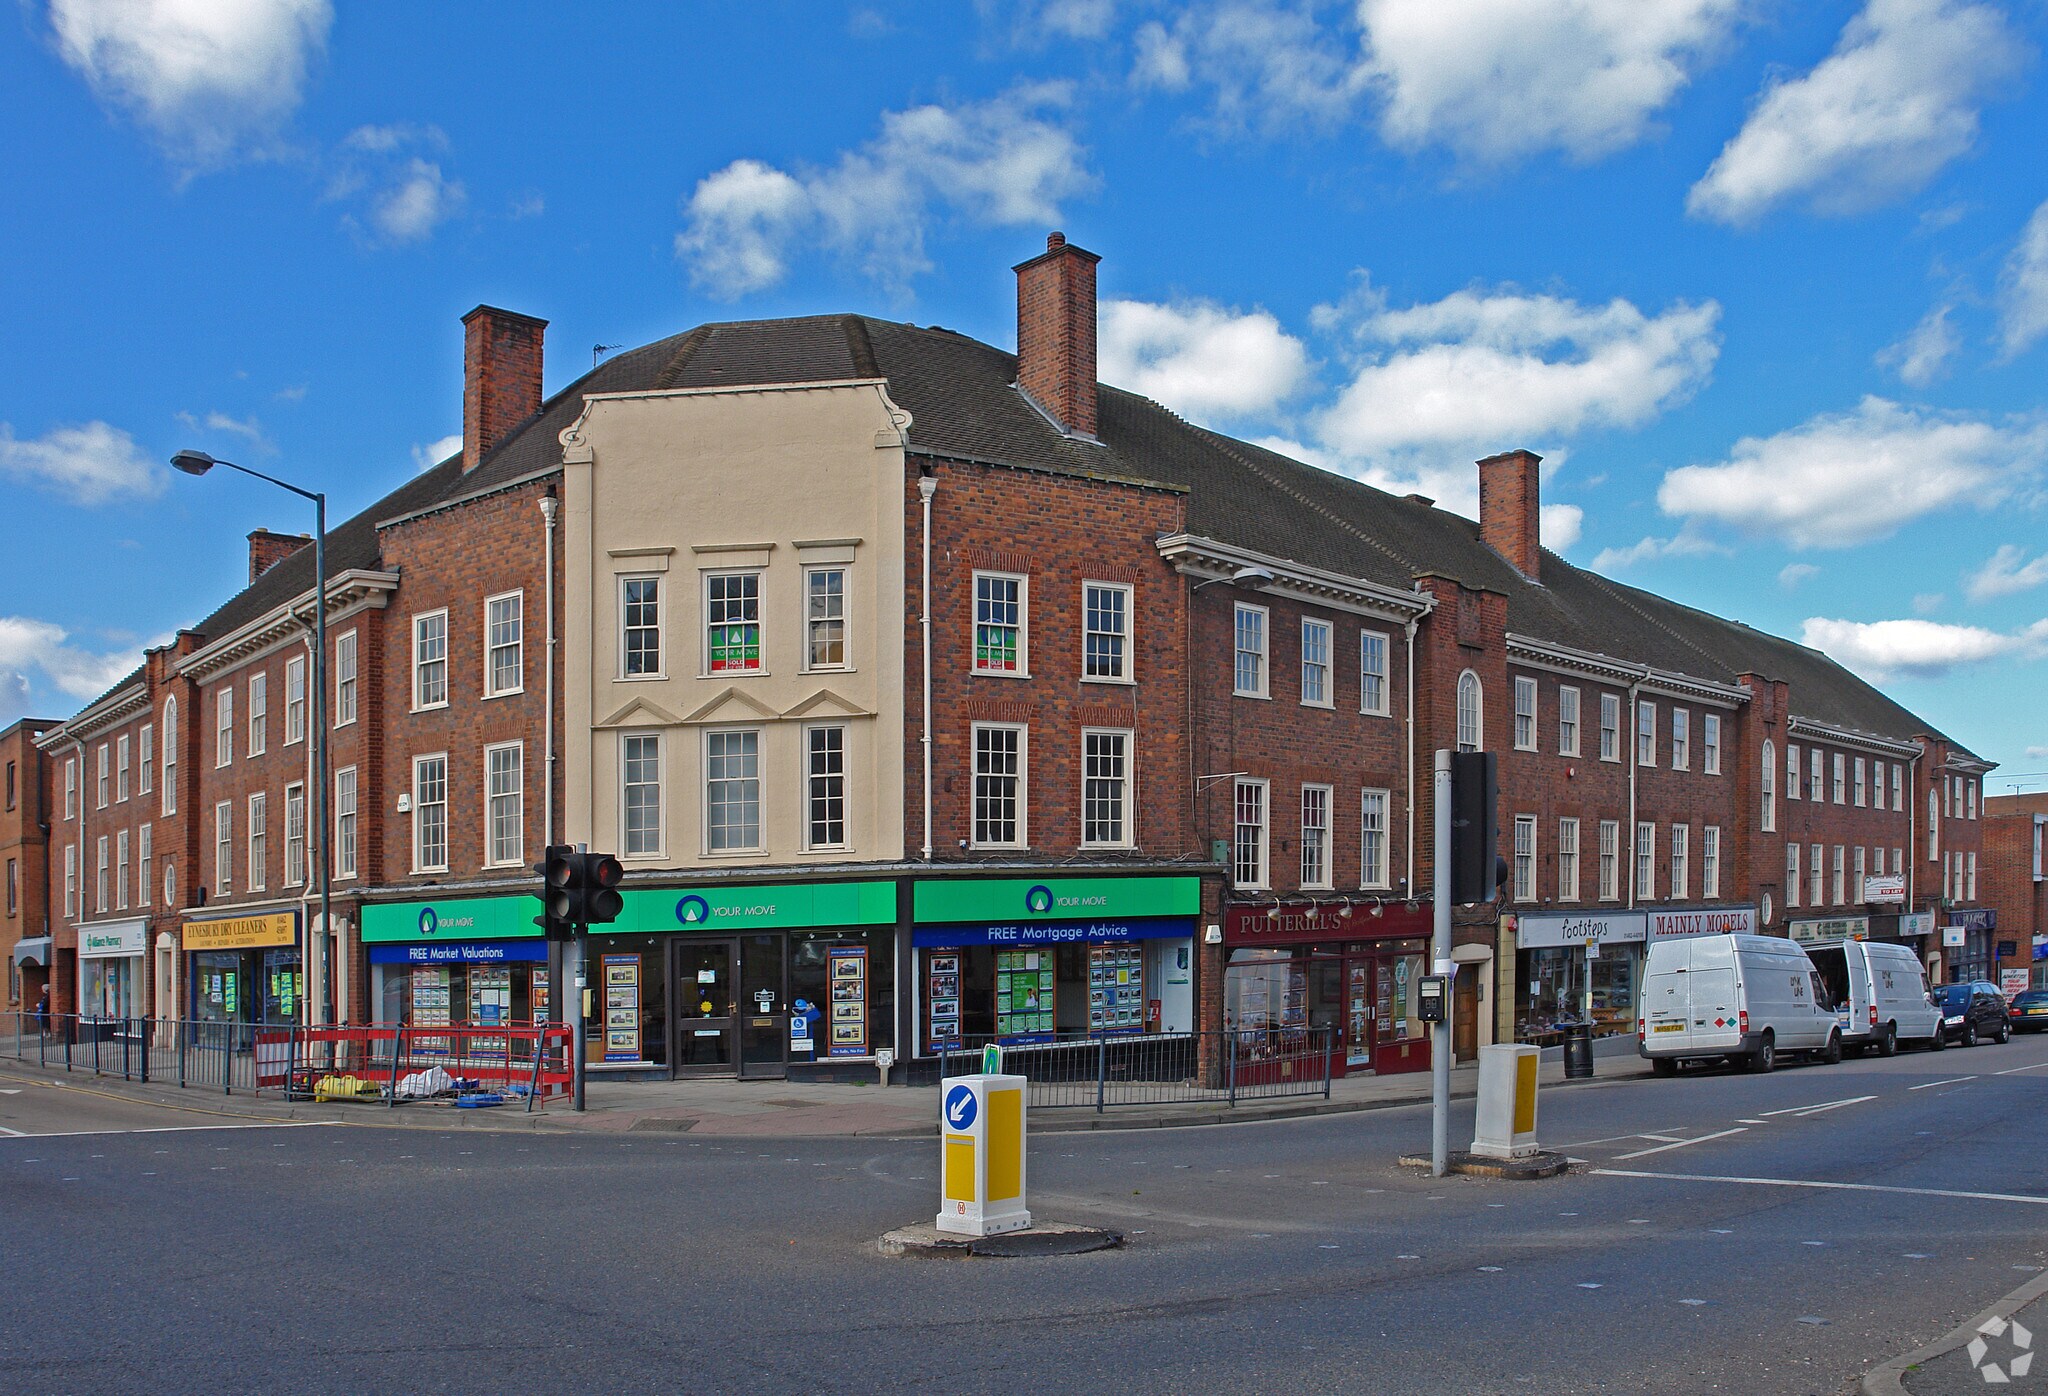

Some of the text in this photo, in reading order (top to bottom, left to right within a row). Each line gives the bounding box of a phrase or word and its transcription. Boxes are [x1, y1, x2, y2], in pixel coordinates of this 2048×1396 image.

[1056, 896, 1106, 906] YOUR MOVE
[712, 905, 776, 916] YOUR MOVE
[188, 924, 220, 938] EYNESBURY
[220, 922, 234, 936] DRY
[234, 918, 267, 935] CLEANERS
[438, 917, 474, 928] YOUR MOVE
[1240, 913, 1341, 934] PUTTERILL'S
[1562, 918, 1608, 939] footsteps
[1656, 914, 1748, 935] MAINLY MODELS
[988, 924, 1128, 941] FREE Mortgage Advice
[409, 946, 504, 960] FREE Market Valuations
[1436, 947, 1441, 955] 7
